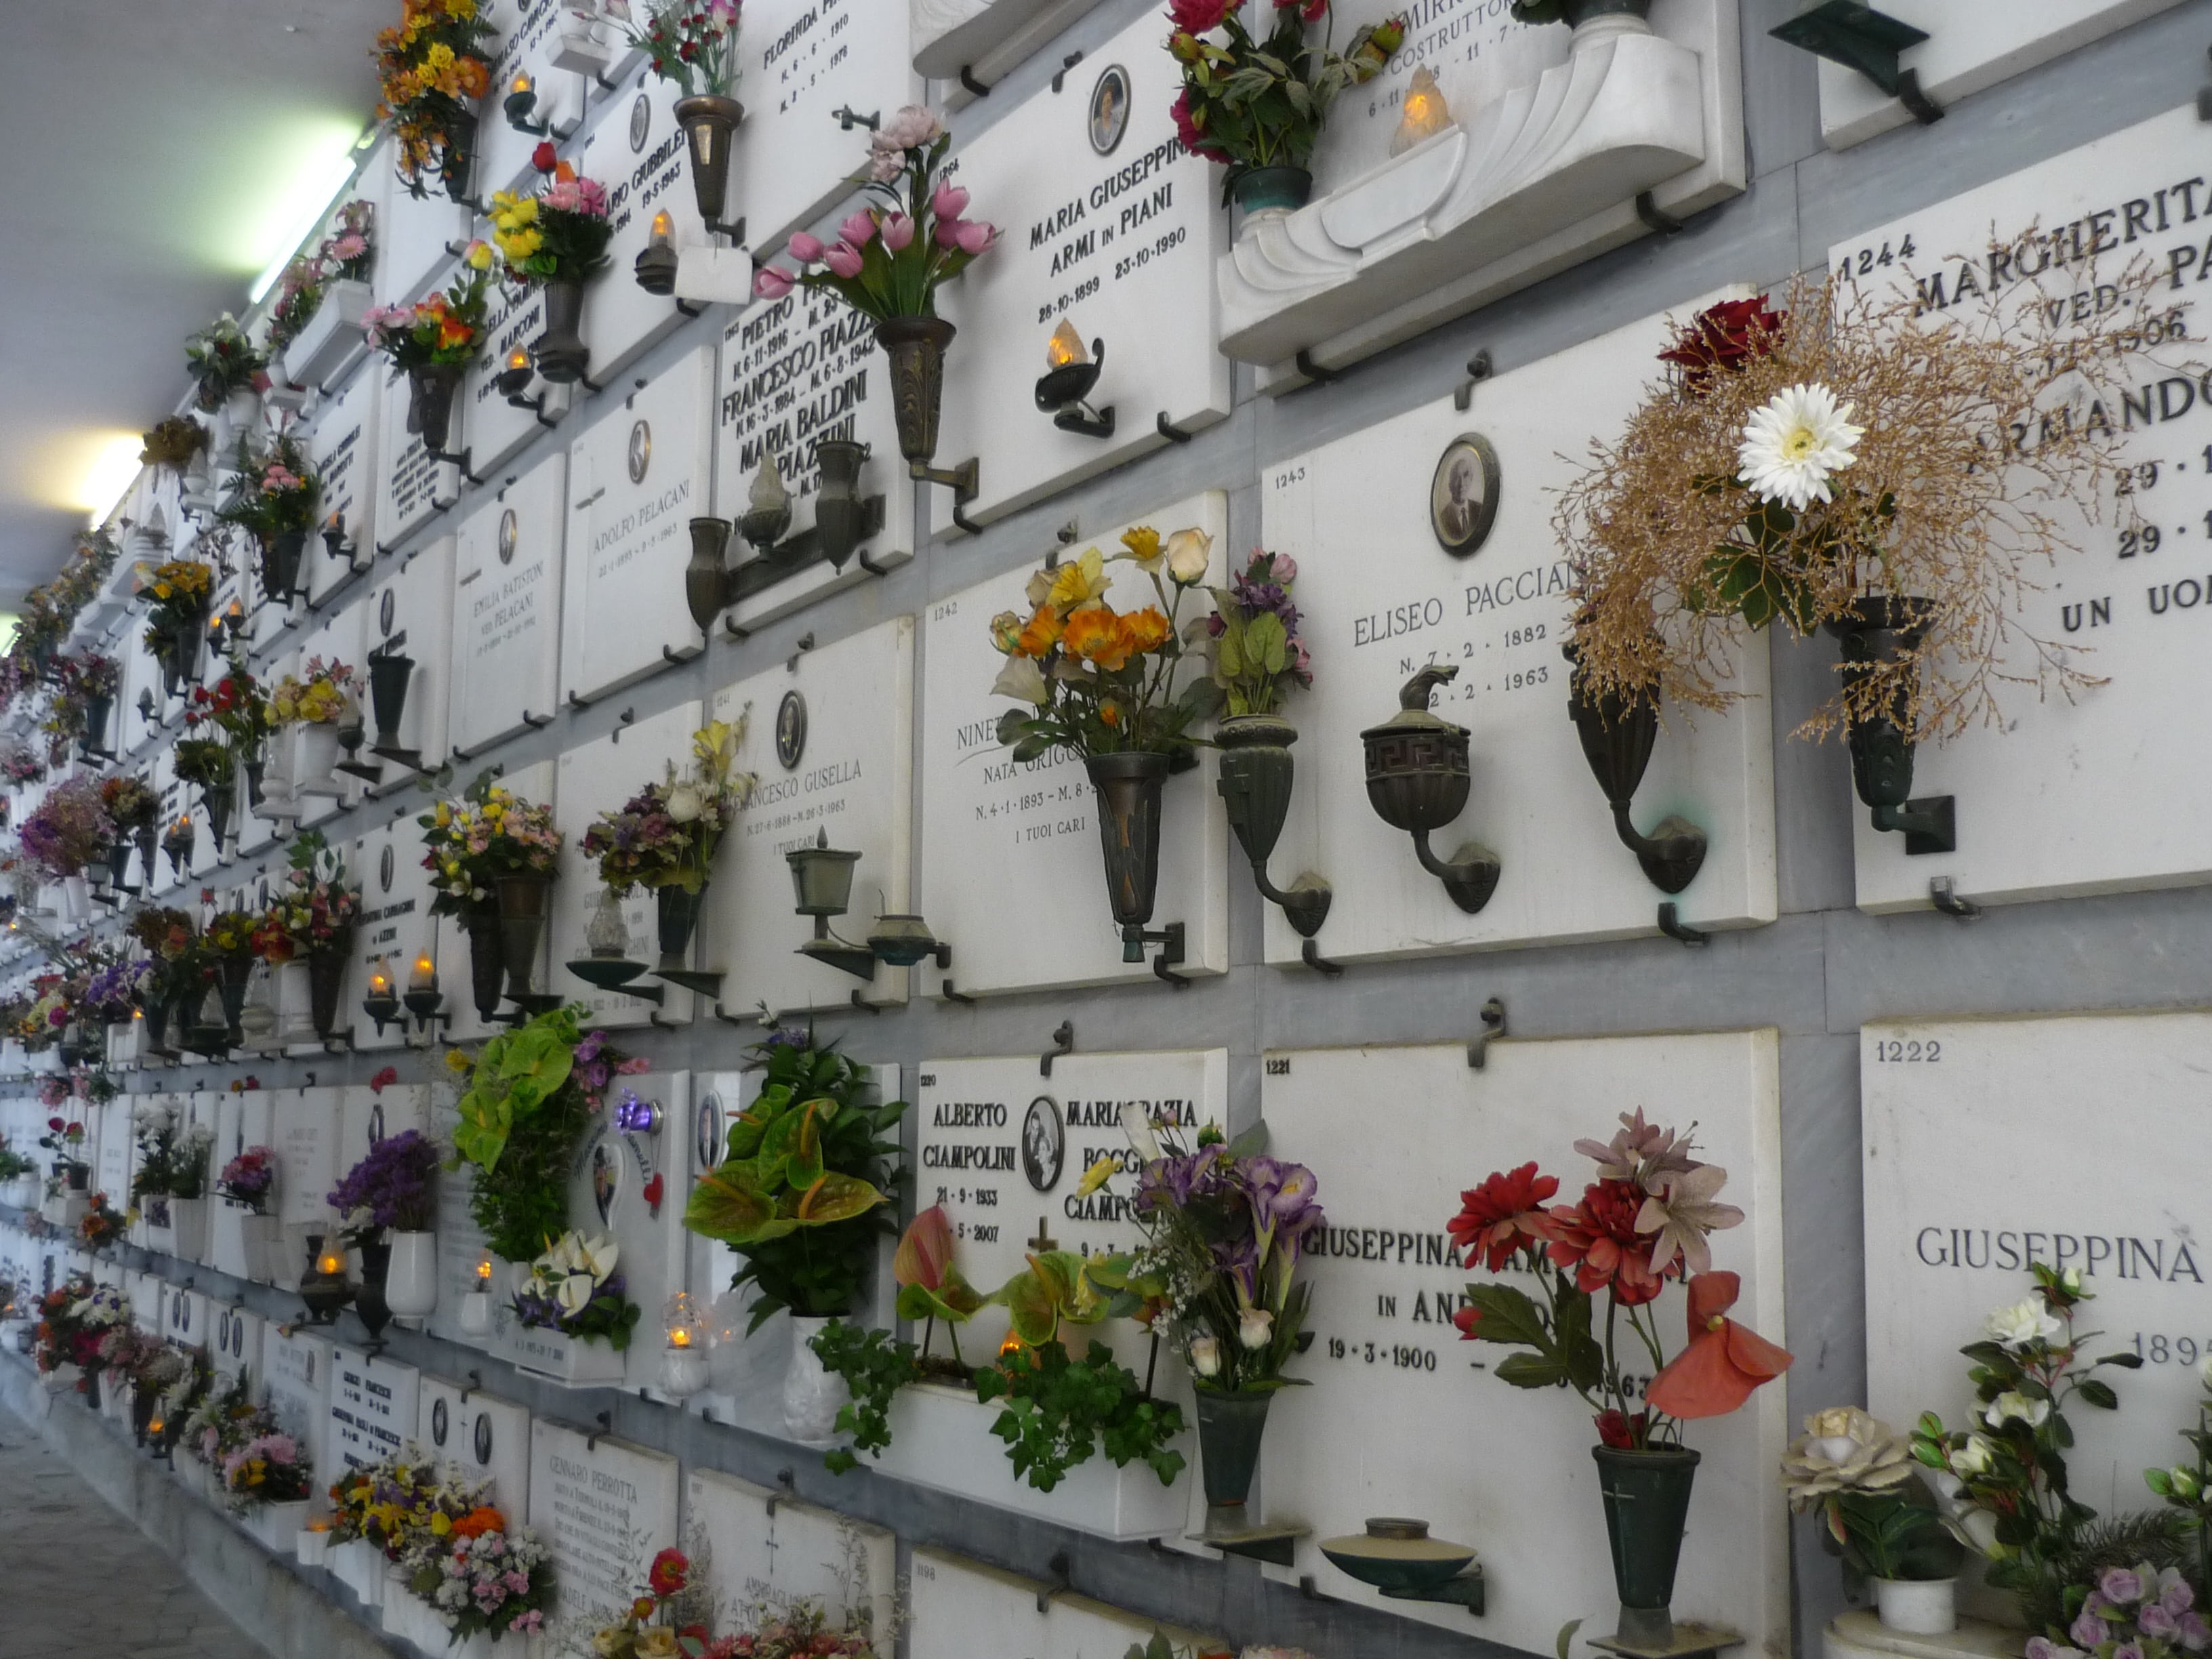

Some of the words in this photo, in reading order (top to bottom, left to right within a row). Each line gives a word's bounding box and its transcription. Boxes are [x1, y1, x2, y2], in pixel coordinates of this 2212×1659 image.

[763, 6, 818, 70] FLORINDA
[1029, 197, 1086, 251] MARIA
[1090, 135, 1190, 210] GIUSEPPIN
[1050, 229, 1095, 279] ARMI
[1102, 225, 1114, 247] IN
[1120, 182, 1173, 236] PIANI
[1911, 176, 2212, 319] MARGHERIT
[1840, 233, 1917, 282] 1244
[742, 295, 794, 350] PIETRO
[722, 340, 817, 427] FRANCESCO
[740, 418, 794, 474] MARIA
[796, 368, 869, 441] BALDINI
[1275, 466, 1306, 490] 1243
[594, 514, 635, 555] ADOLFO
[639, 478, 690, 527] PELACANI
[2118, 526, 2161, 559] 29
[1354, 597, 1444, 649] ELISEO
[2062, 597, 2112, 632] UN
[2148, 574, 2212, 615] UO
[1399, 657, 1416, 675] N.
[1504, 623, 1547, 648] 1882
[1504, 665, 1549, 691] 1963
[734, 777, 798, 813] FANCESCO
[804, 758, 862, 793] GUSELLA
[1026, 823, 1052, 842] TUOI
[1057, 816, 1086, 834] CARI
[1266, 1058, 1290, 1075] 1221
[1876, 1040, 1942, 1063] 1222
[933, 1103, 1008, 1127] ALBERTO
[923, 1145, 1016, 1171] CIAMPOLINI
[1916, 1227, 2205, 1284] GIUSEPPINA
[1378, 1295, 1396, 1317] IN
